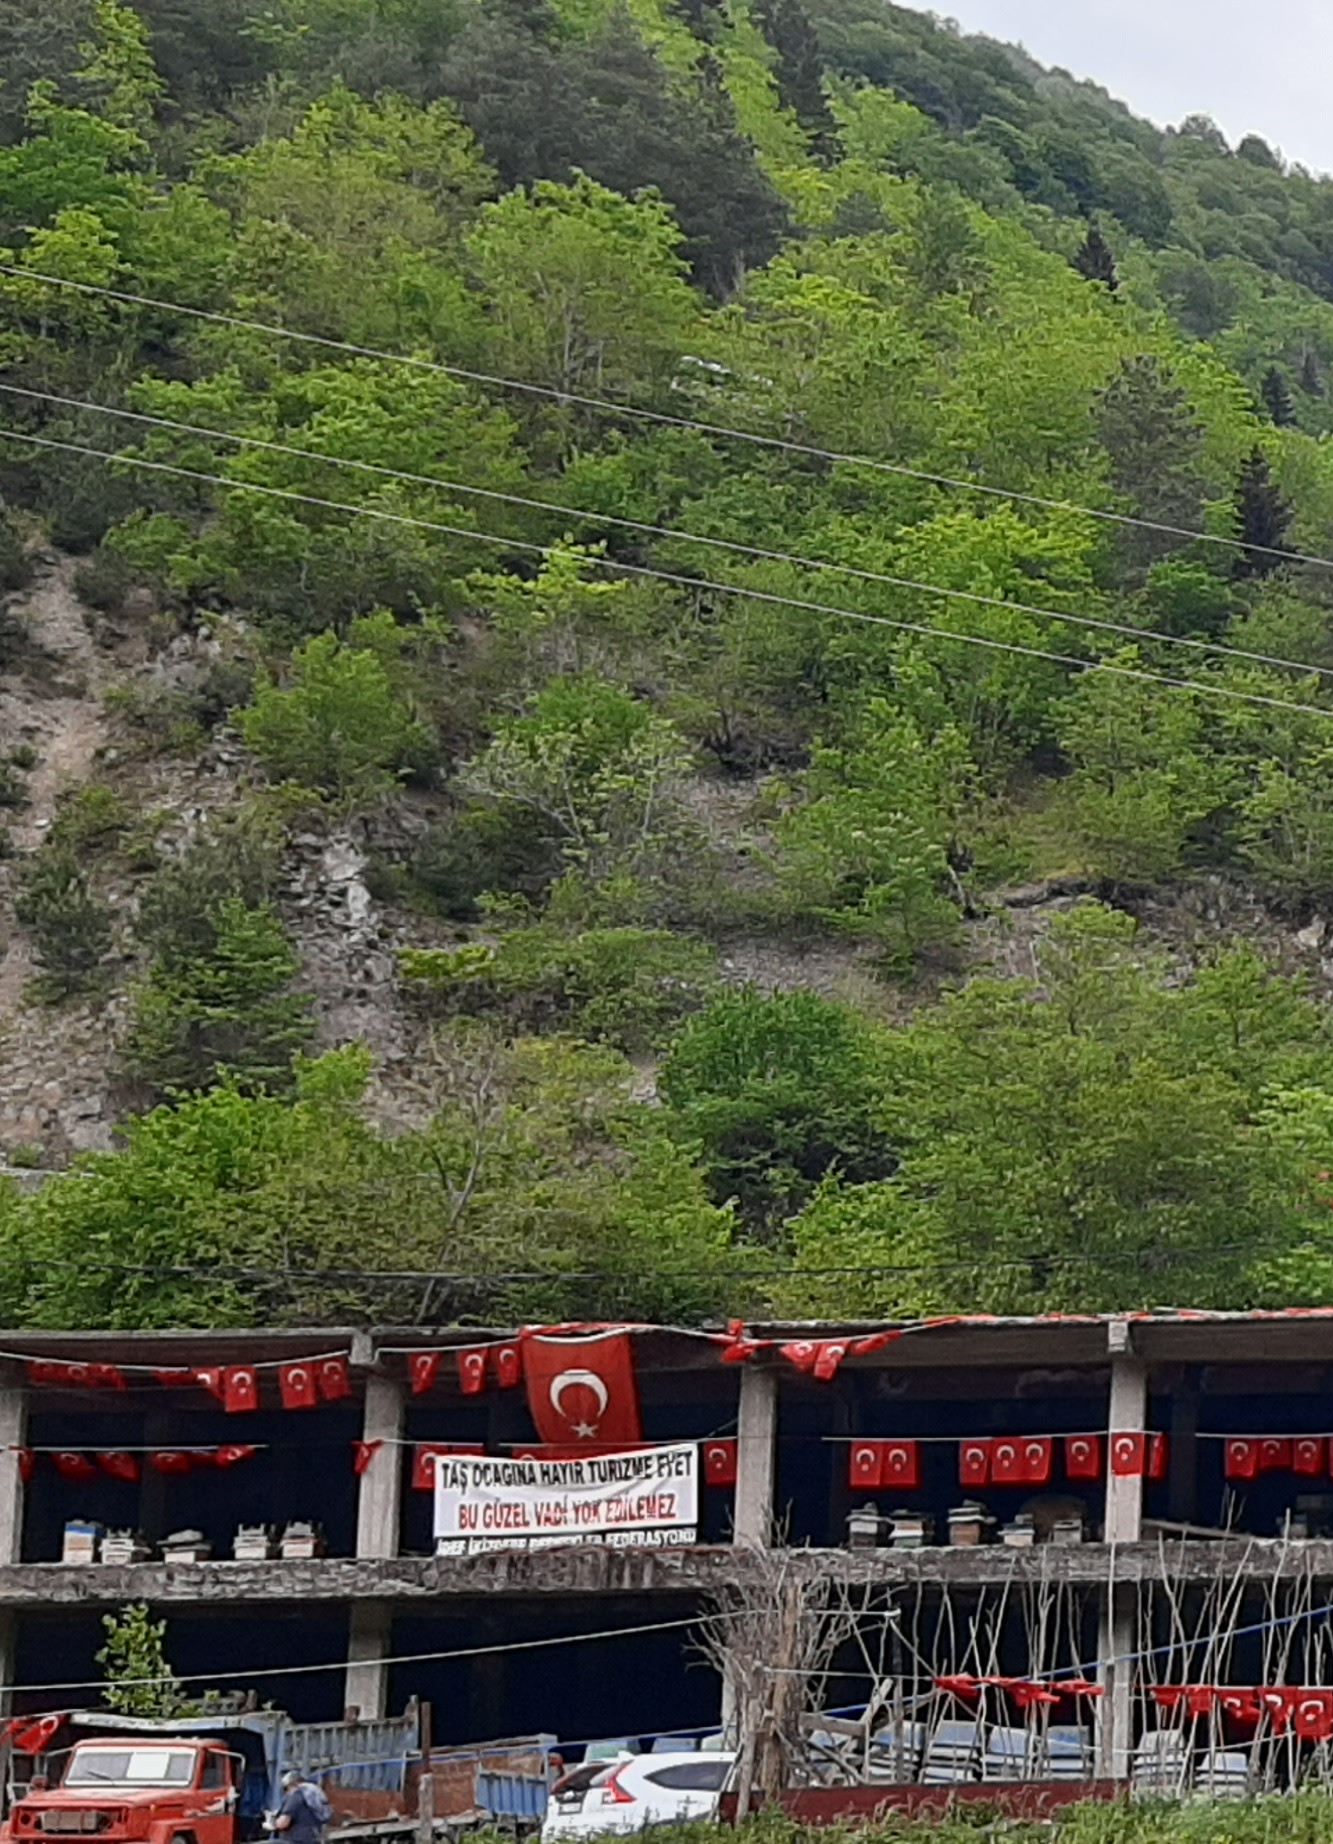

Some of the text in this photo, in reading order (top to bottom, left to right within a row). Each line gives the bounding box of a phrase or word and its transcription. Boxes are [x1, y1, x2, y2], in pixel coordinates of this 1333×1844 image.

[441, 1463, 469, 1495] TAŞ
[540, 1460, 585, 1487] HAYIR
[459, 1502, 478, 1530] BU
[482, 1496, 530, 1529] GÜZEL
